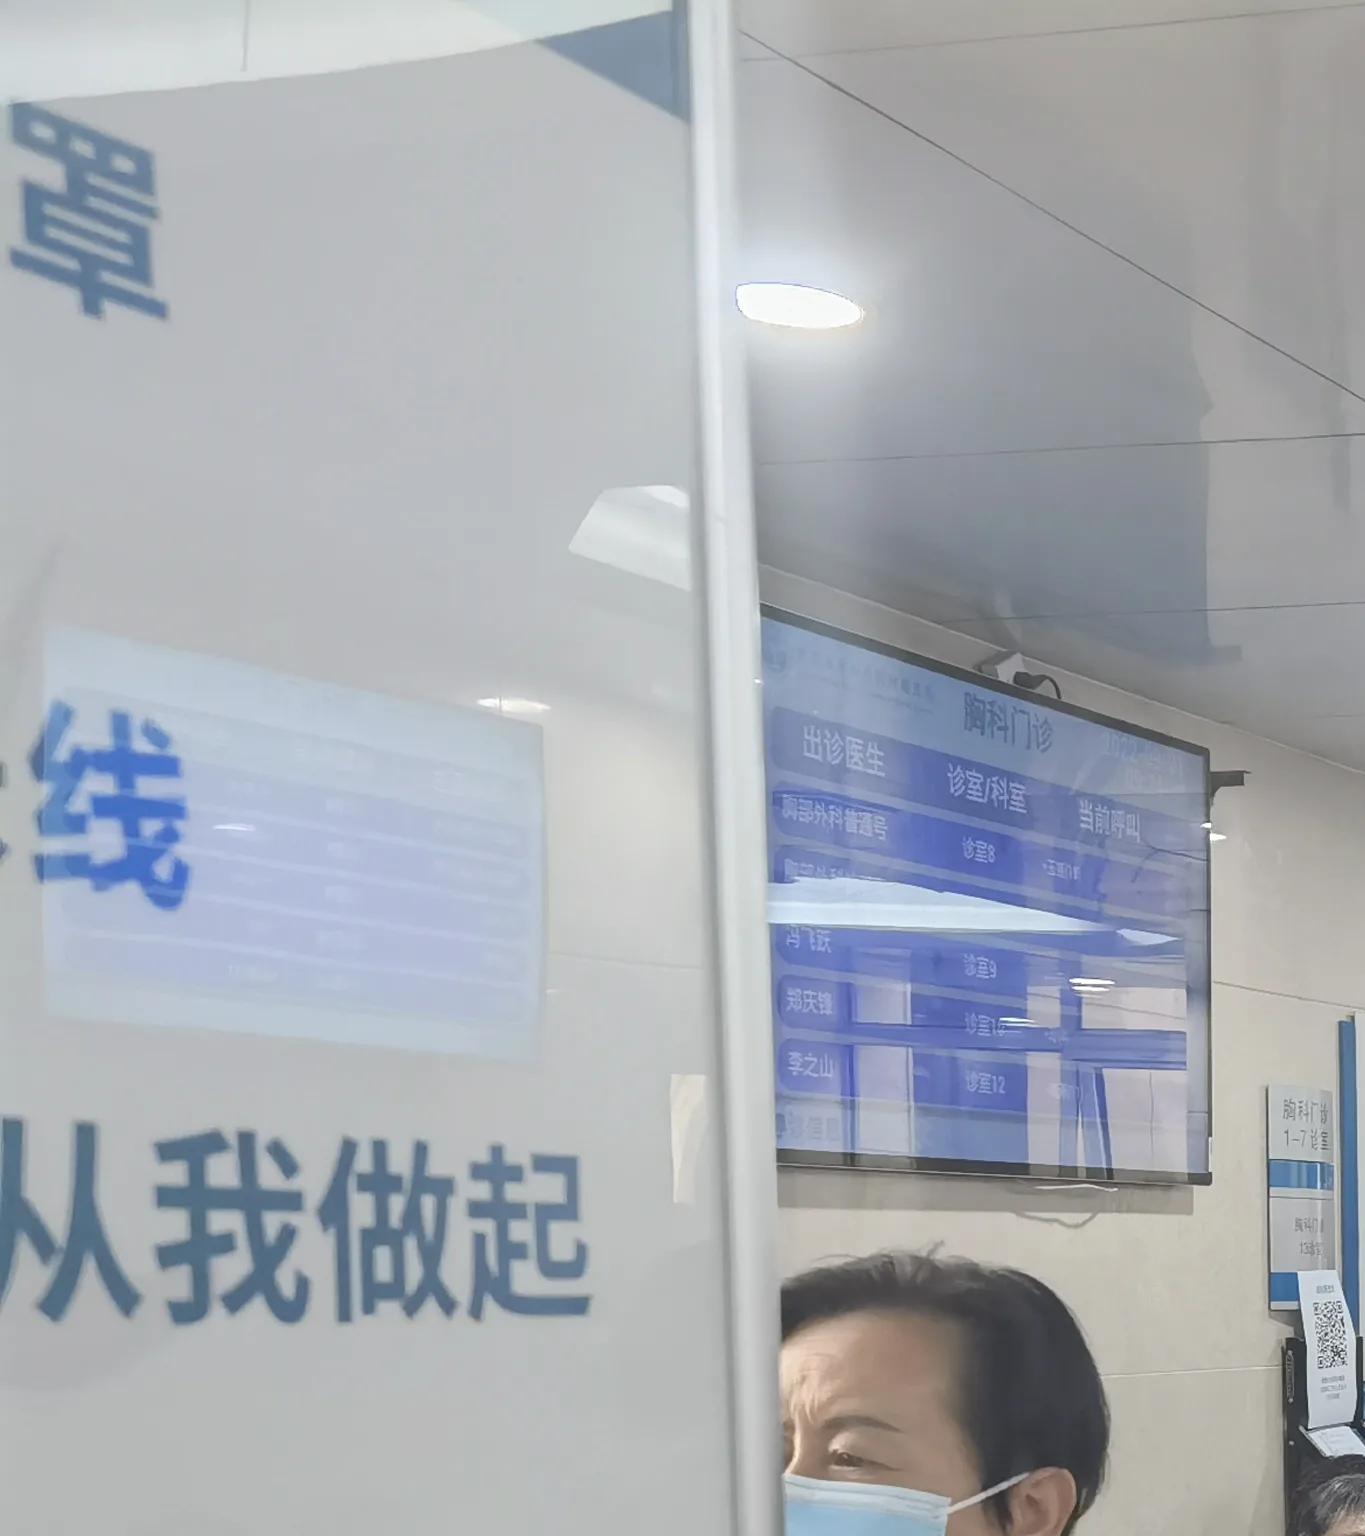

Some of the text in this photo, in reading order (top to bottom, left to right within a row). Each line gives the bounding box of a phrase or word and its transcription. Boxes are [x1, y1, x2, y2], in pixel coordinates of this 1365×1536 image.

[8, 101, 170, 319] 罩
[963, 691, 1054, 754] 胸科门诊
[803, 724, 886, 778] 出诊医生
[946, 762, 1028, 814] 诊室/科室
[1079, 799, 1141, 844] 当前呼叫
[787, 1051, 835, 1079] 李之山
[0, 1116, 593, 1326] 从我做起
